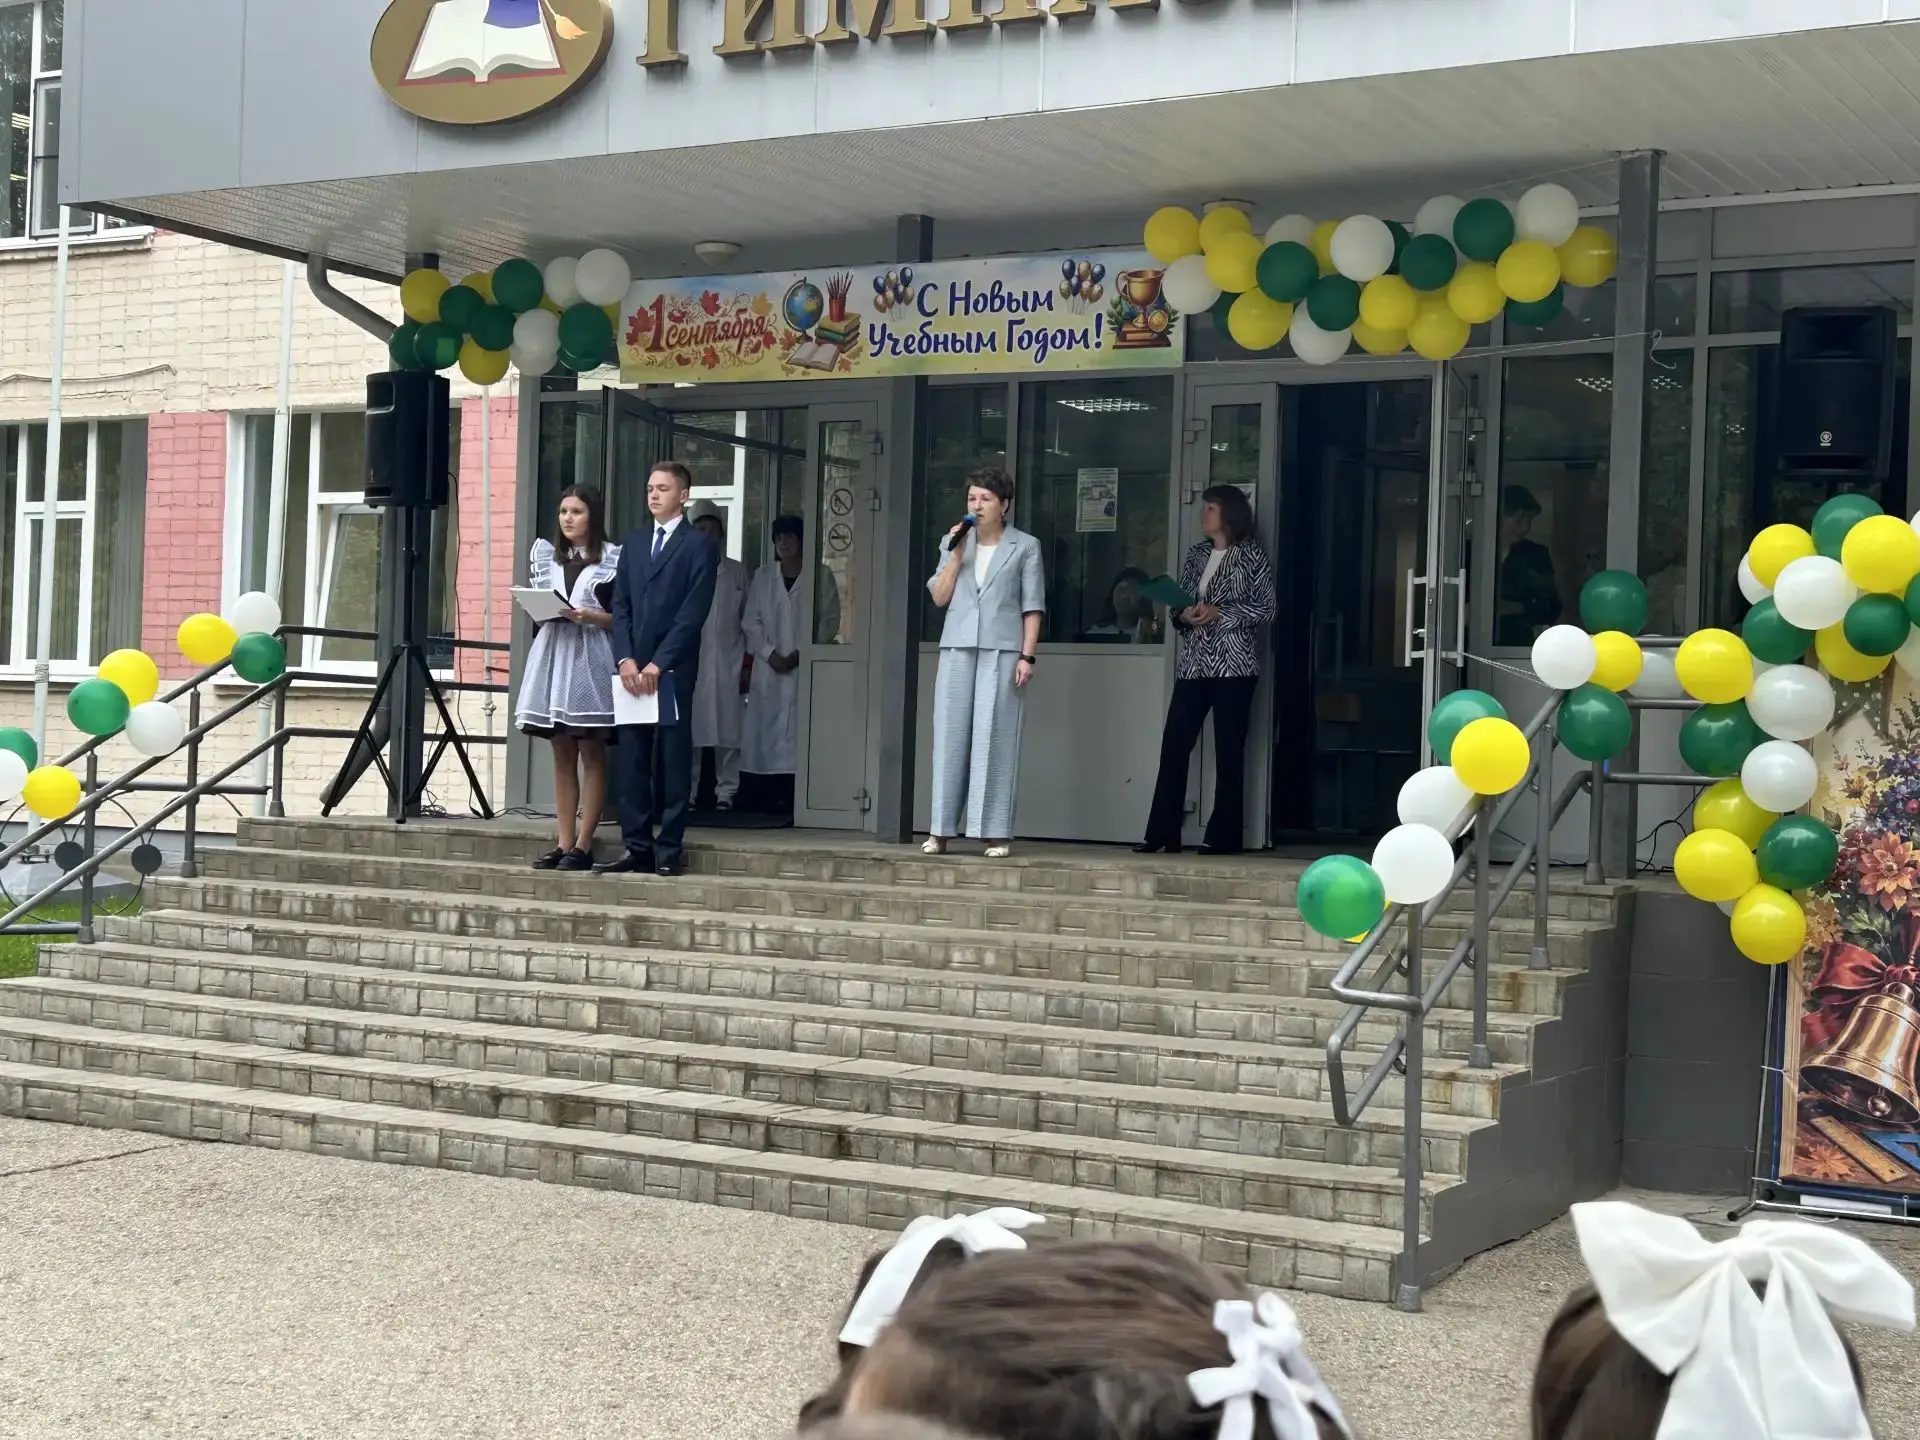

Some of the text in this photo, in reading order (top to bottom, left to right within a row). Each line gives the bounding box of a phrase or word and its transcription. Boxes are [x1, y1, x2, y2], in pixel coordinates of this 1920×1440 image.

[917, 280, 1054, 317] С Новым
[644, 294, 768, 355] 1 сентября
[869, 313, 1103, 364] Учебным Годом!
